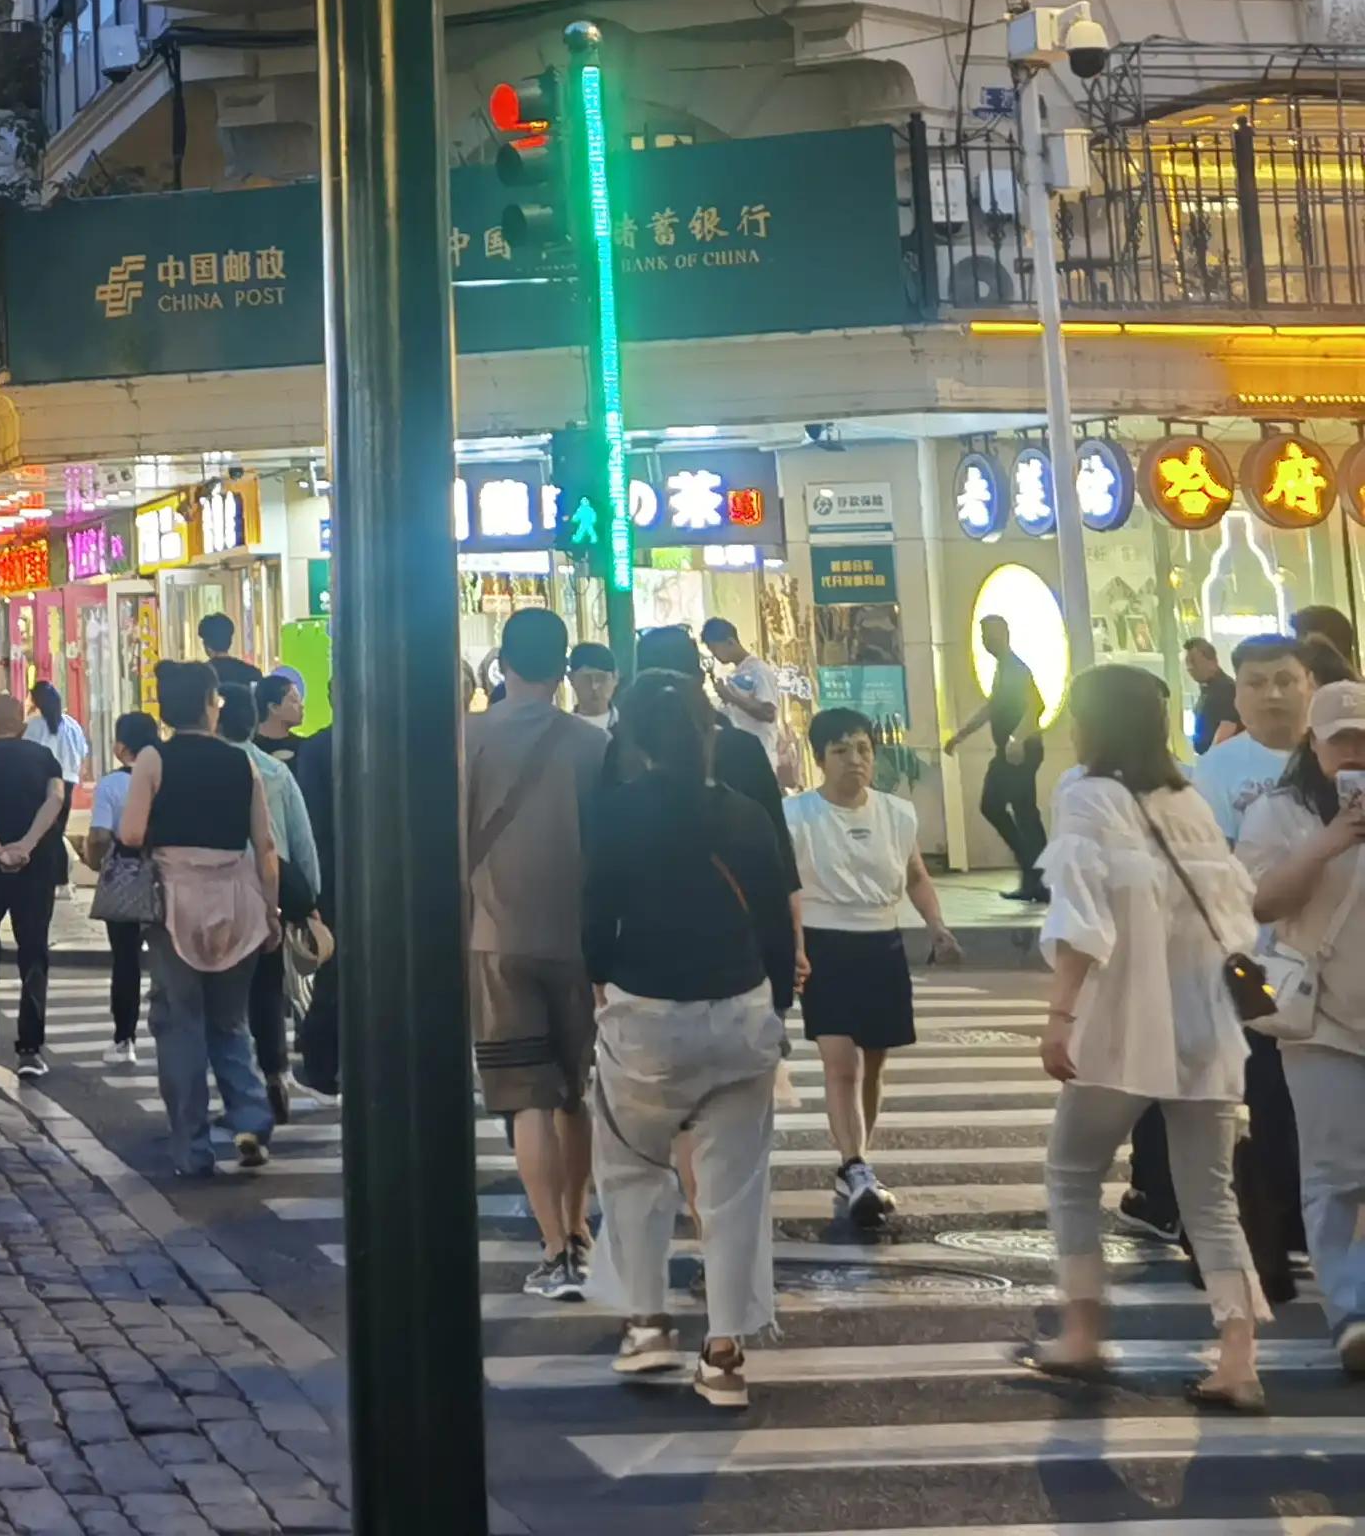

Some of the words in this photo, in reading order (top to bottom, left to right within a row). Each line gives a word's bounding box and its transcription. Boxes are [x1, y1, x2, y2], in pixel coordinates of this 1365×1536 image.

[157, 246, 286, 289] 中国邮政
[675, 254, 697, 269] OF
[702, 248, 760, 267] CHINA
[157, 291, 224, 313] CHINA
[235, 286, 286, 307] POST
[1157, 441, 1365, 517] 哈府
